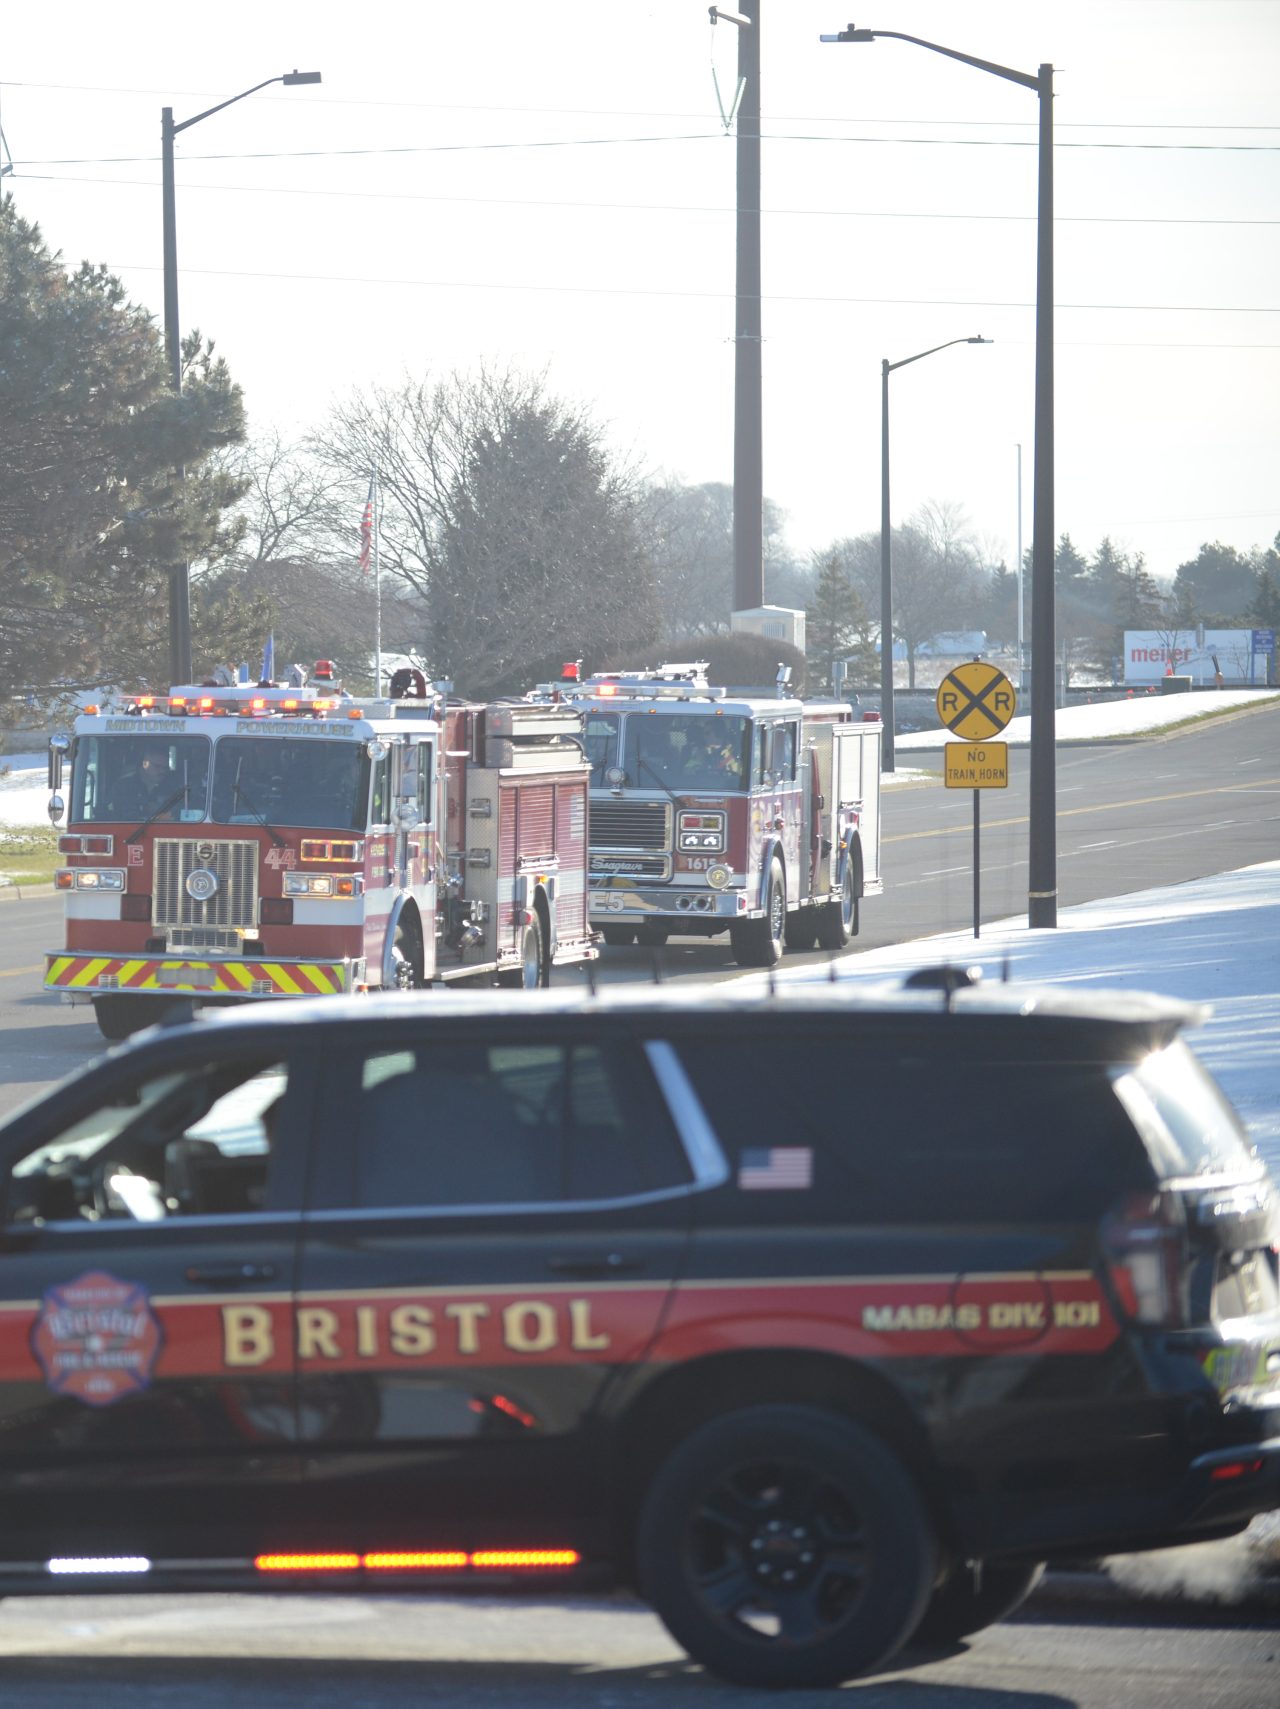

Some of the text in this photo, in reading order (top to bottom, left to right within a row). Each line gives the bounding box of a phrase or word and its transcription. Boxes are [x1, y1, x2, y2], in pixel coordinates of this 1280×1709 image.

[942, 692, 1011, 711] R R
[105, 719, 354, 737] MIDTOWN POWERHOUSE
[967, 751, 986, 762] NO
[948, 768, 1005, 779] TRAIN HORN
[127, 844, 144, 866] E
[264, 848, 297, 870] 44
[589, 891, 625, 912] E5
[862, 1304, 981, 1330] MABAS
[222, 1300, 610, 1366] BRISTOL
